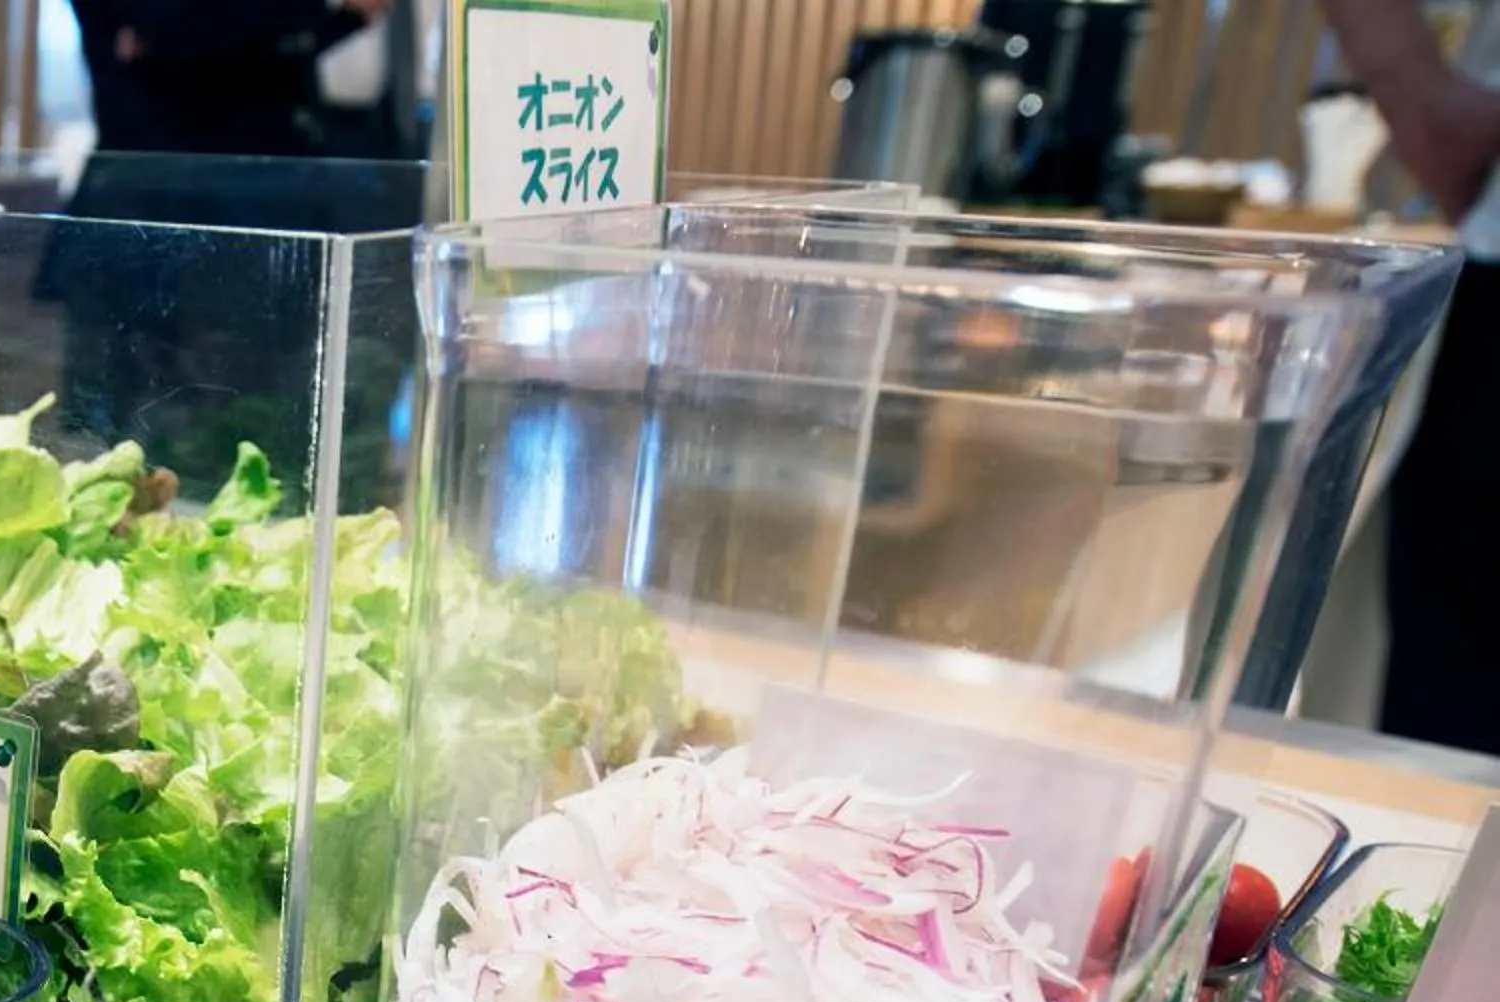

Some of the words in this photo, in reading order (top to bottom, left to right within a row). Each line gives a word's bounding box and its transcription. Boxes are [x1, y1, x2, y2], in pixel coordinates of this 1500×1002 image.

[517, 72, 625, 131] オニオン
[520, 147, 619, 205] スライス
